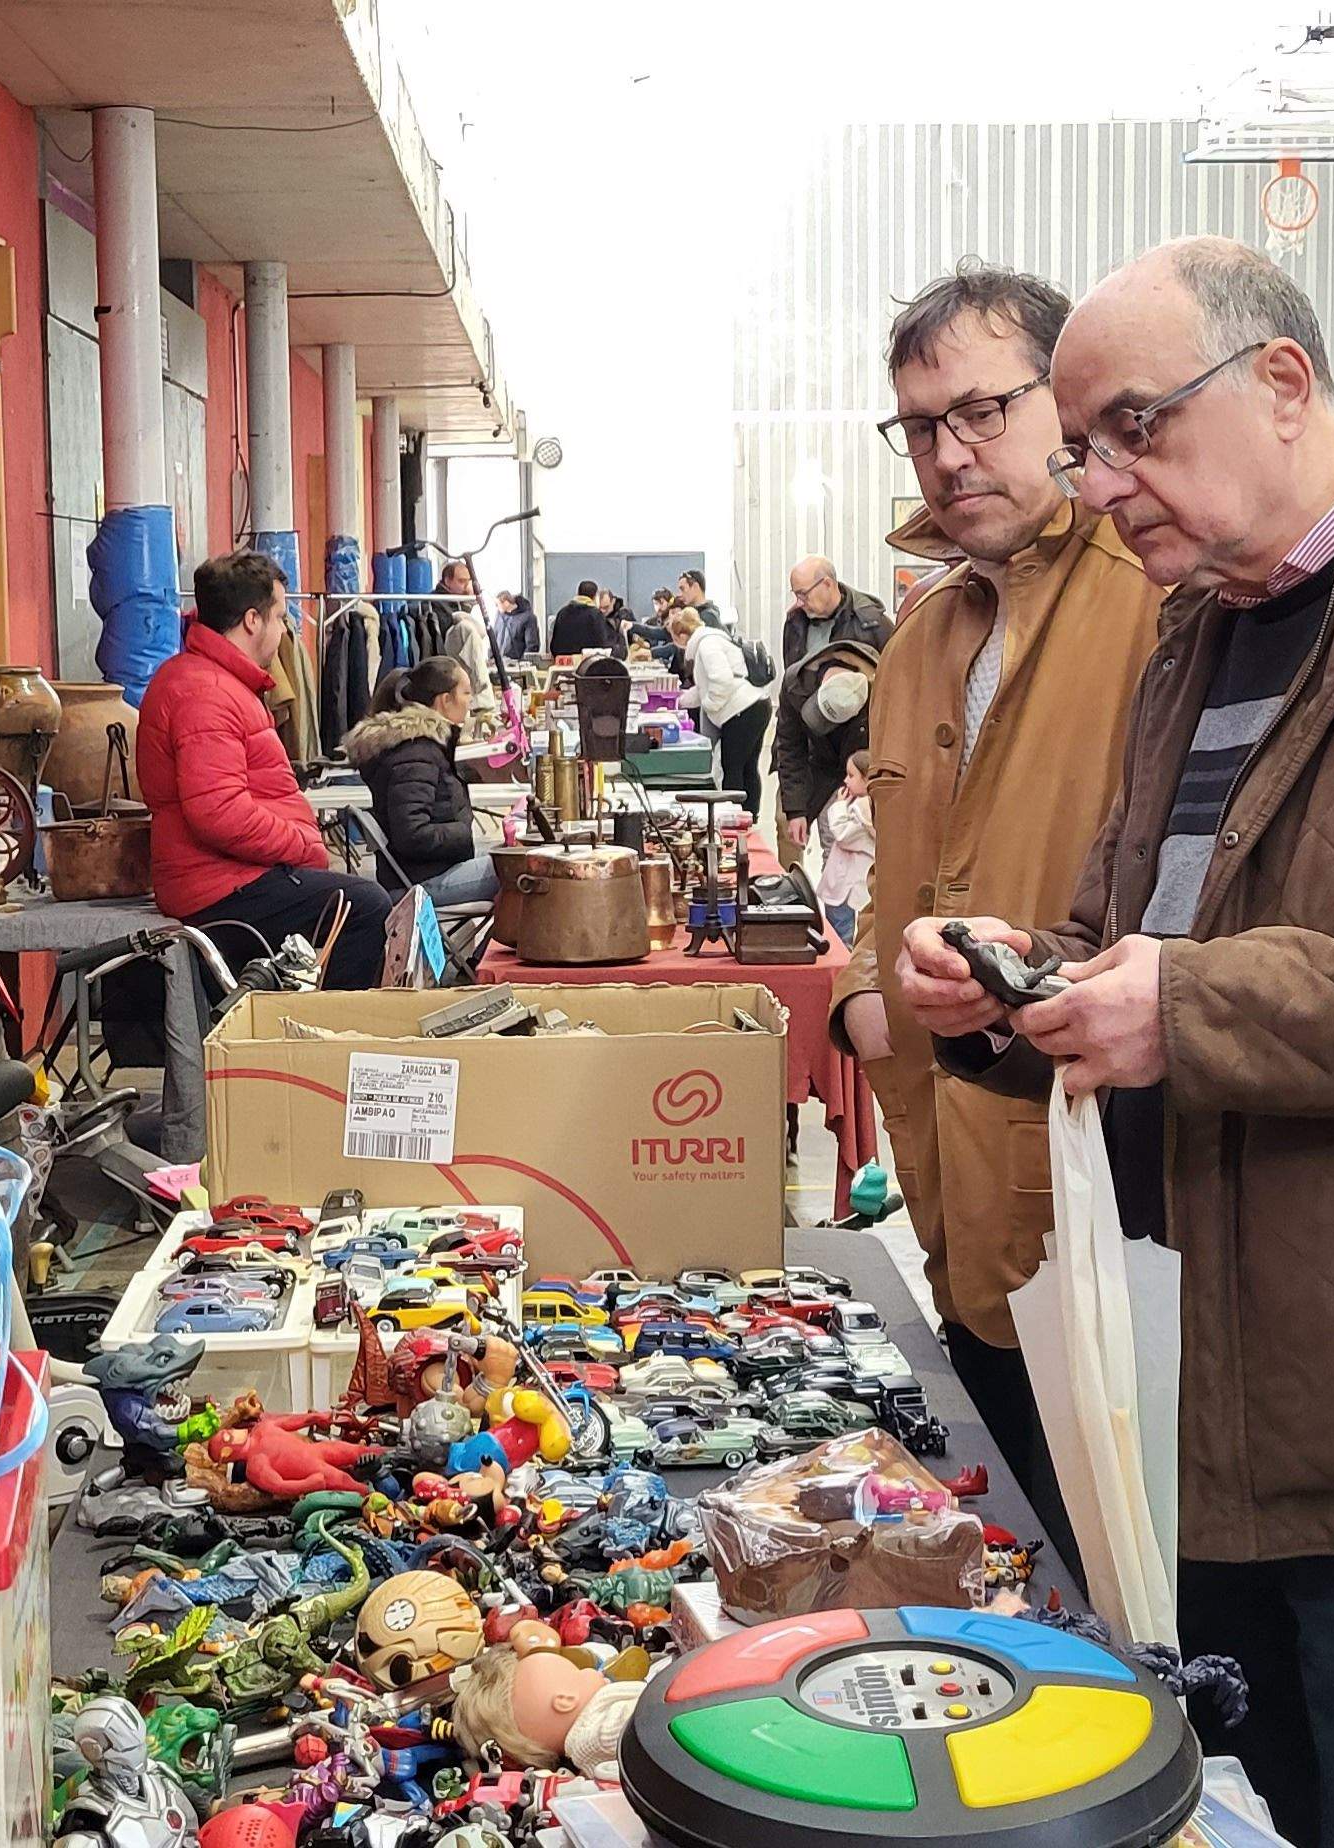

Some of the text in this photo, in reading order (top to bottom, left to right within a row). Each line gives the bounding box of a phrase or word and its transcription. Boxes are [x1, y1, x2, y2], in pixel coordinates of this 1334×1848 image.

[401, 1064, 437, 1077] ZARAGOZA
[428, 1092, 444, 1104] Z10
[632, 1137, 744, 1165] ITURRI
[633, 1171, 745, 1182] Your safety matters
